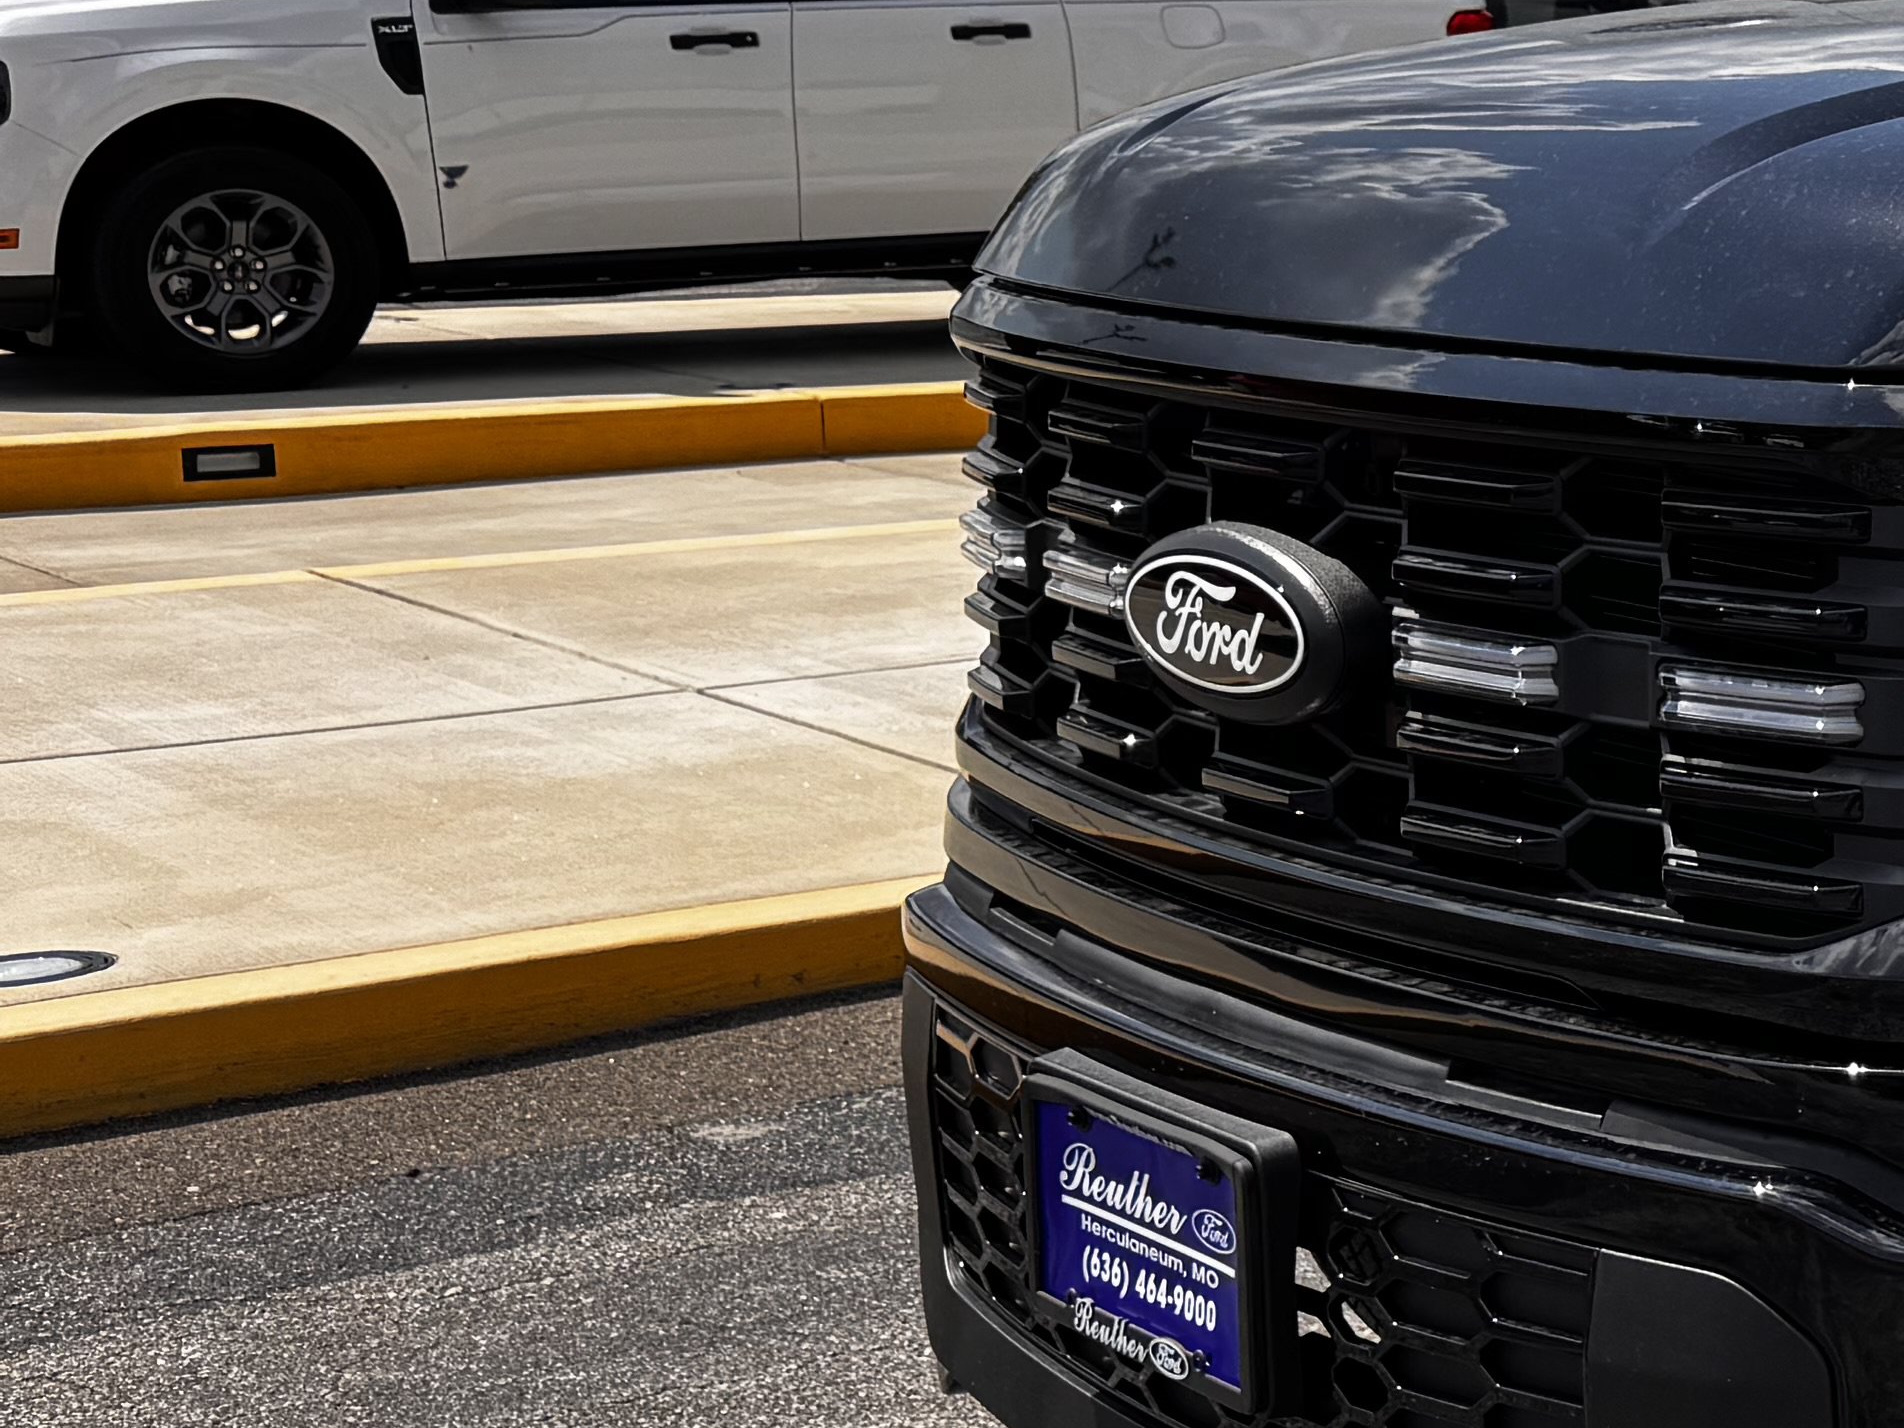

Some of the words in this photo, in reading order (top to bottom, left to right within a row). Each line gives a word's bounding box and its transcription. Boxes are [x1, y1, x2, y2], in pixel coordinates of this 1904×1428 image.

[378, 24, 413, 34] XLT
[1156, 570, 1266, 675] Ford
[1059, 1142, 1188, 1235] Reuther
[1201, 1213, 1229, 1249] Ford
[1081, 1212, 1187, 1278] Herculaneum,
[1191, 1262, 1220, 1289] MO
[1082, 1245, 1130, 1299] (636)
[1134, 1269, 1217, 1332] 464-9000
[1073, 1297, 1149, 1363] Reuther
[1156, 1343, 1182, 1375] Ford
